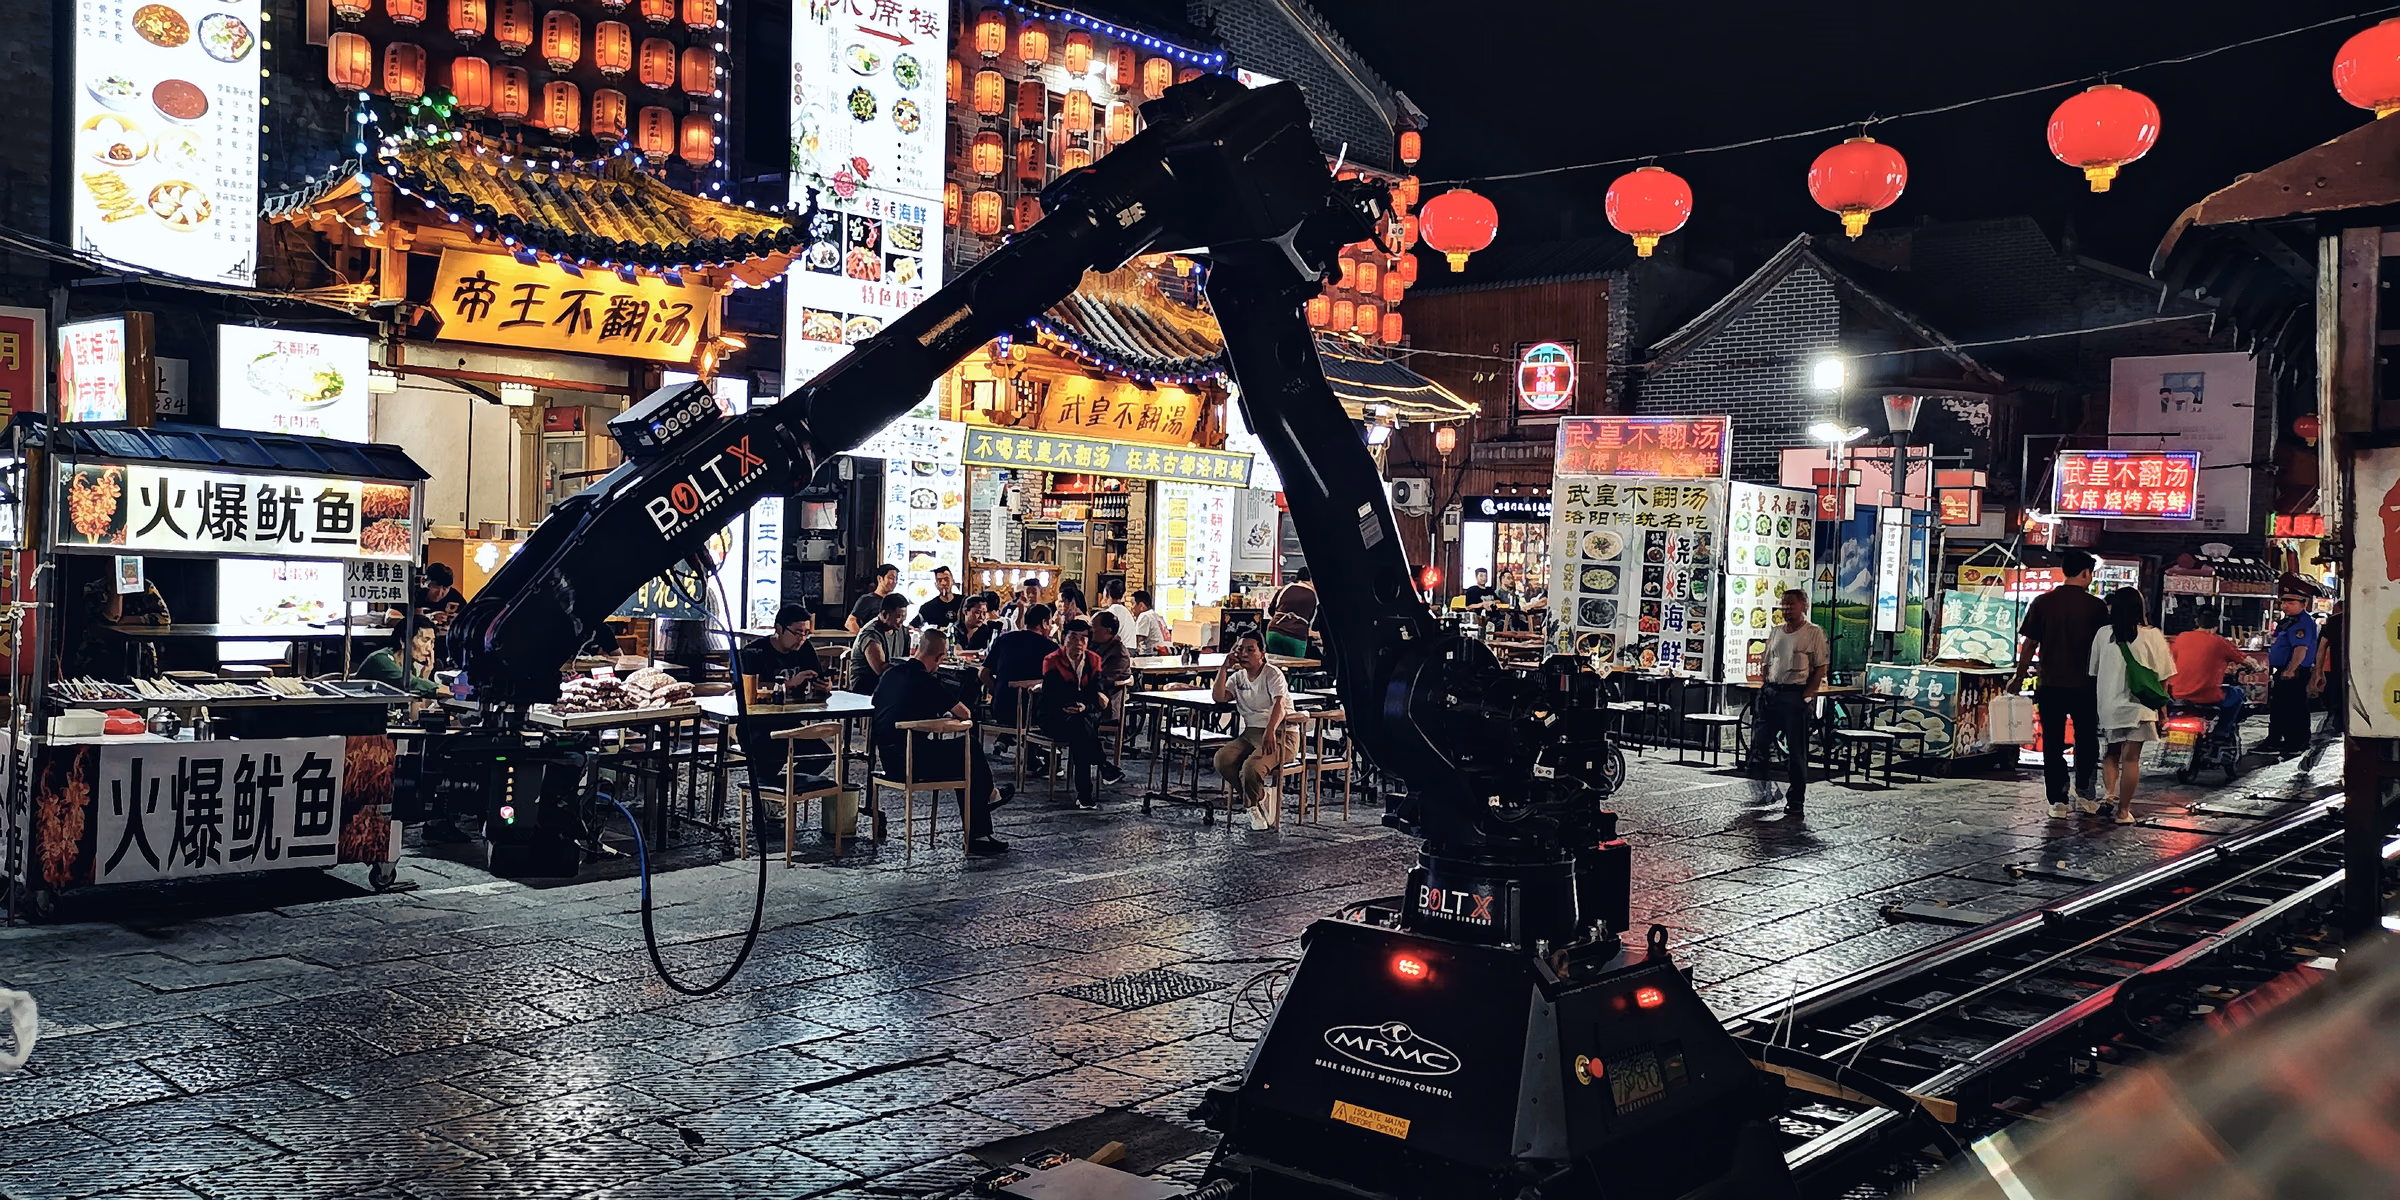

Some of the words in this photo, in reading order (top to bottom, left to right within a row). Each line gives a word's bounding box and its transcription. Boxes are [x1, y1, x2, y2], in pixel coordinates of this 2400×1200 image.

[452, 269, 693, 347] 帝王不翻汤
[273, 339, 320, 357] 不翻汤
[273, 413, 320, 430] 牛肉汤
[1565, 422, 1720, 451] 武皇不翻汤
[974, 435, 1112, 470] 不喝武皇不翻汤
[645, 454, 729, 534] BOLT
[726, 435, 765, 477] X
[2062, 459, 2189, 489] 武皇不翻汤
[136, 477, 360, 545] 火爆鱿鱼
[1566, 483, 1709, 512] 武皇不翻汤
[2061, 490, 2100, 511] 水席
[2103, 489, 2143, 511] 烧烤
[2146, 490, 2187, 513] 海鲜
[1209, 497, 1224, 544] 不翻汤
[1564, 510, 1709, 530] 洛阳传统名吃
[347, 561, 405, 583] 火爆鱿鱼
[350, 585, 402, 601] 10元5串
[105, 751, 337, 876] 火爆鱿鱼
[1419, 885, 1469, 915] BOLT
[1470, 893, 1494, 920] X
[1333, 1032, 1450, 1070] MRMC
[1315, 1058, 1338, 1070] MARK
[1340, 1064, 1375, 1080] ROBERTS
[1378, 1073, 1412, 1088] MOTION
[1413, 1082, 1453, 1099] CONTROL
[1347, 1115, 1374, 1129] BEFORE
[1375, 1123, 1406, 1138] OPENING
[1353, 1107, 1382, 1122] ISOLATE
[1384, 1116, 1407, 1130] MAINS
